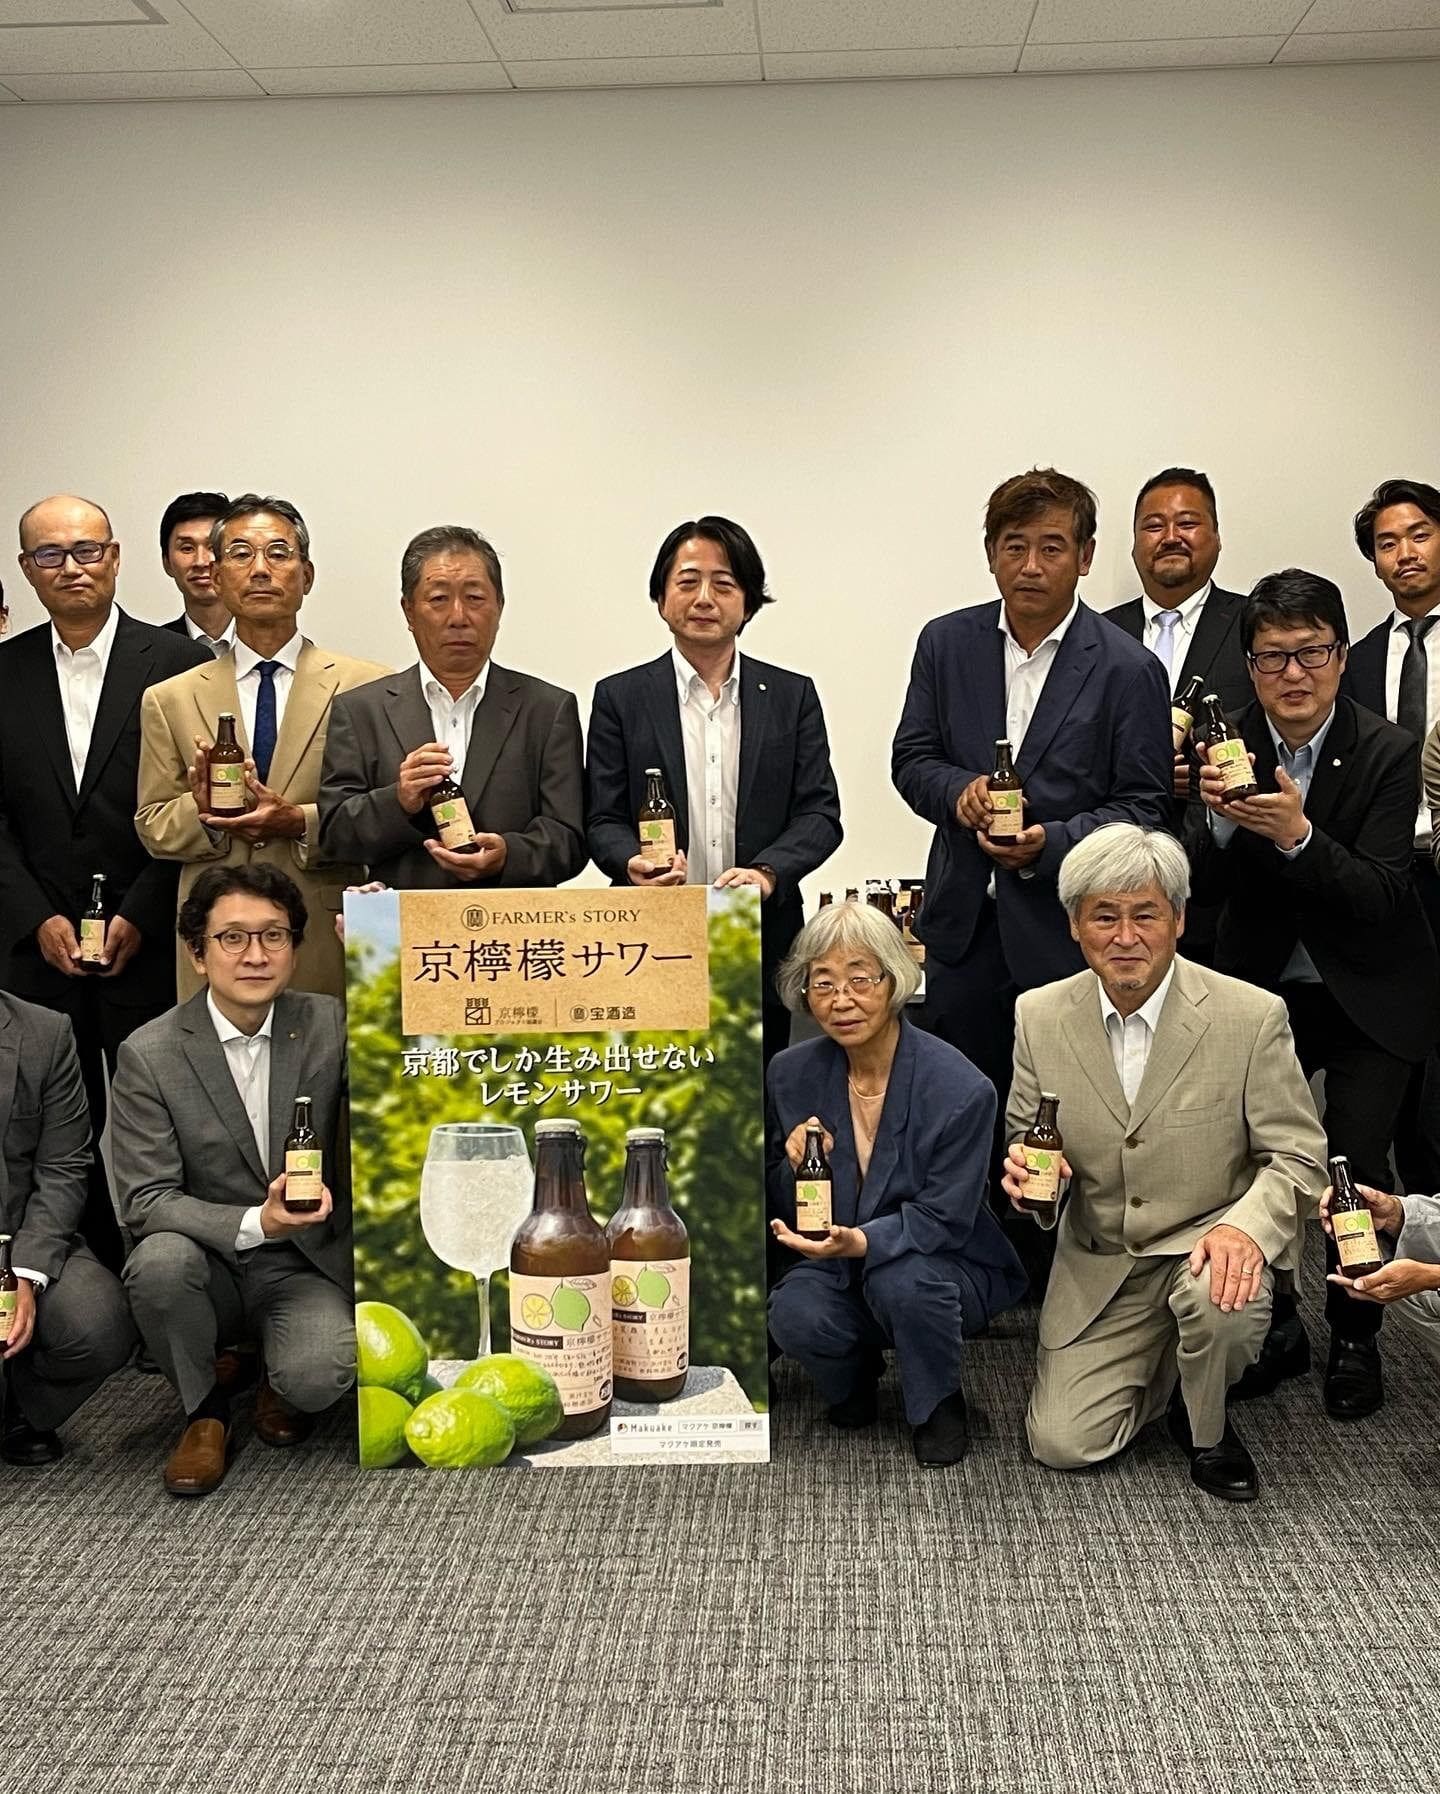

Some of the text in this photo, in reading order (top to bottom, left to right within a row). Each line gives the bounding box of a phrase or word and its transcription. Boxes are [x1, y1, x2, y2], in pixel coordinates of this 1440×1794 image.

[492, 911, 576, 924] FARMER's
[583, 909, 641, 923] STORY
[411, 938, 693, 983] 京檸檬サワー
[590, 1006, 636, 1021] 宝酒造
[401, 1043, 716, 1078] 京都でしか生み出せない
[480, 1078, 643, 1107] レモンサワー
[630, 1423, 673, 1433] Makuake
